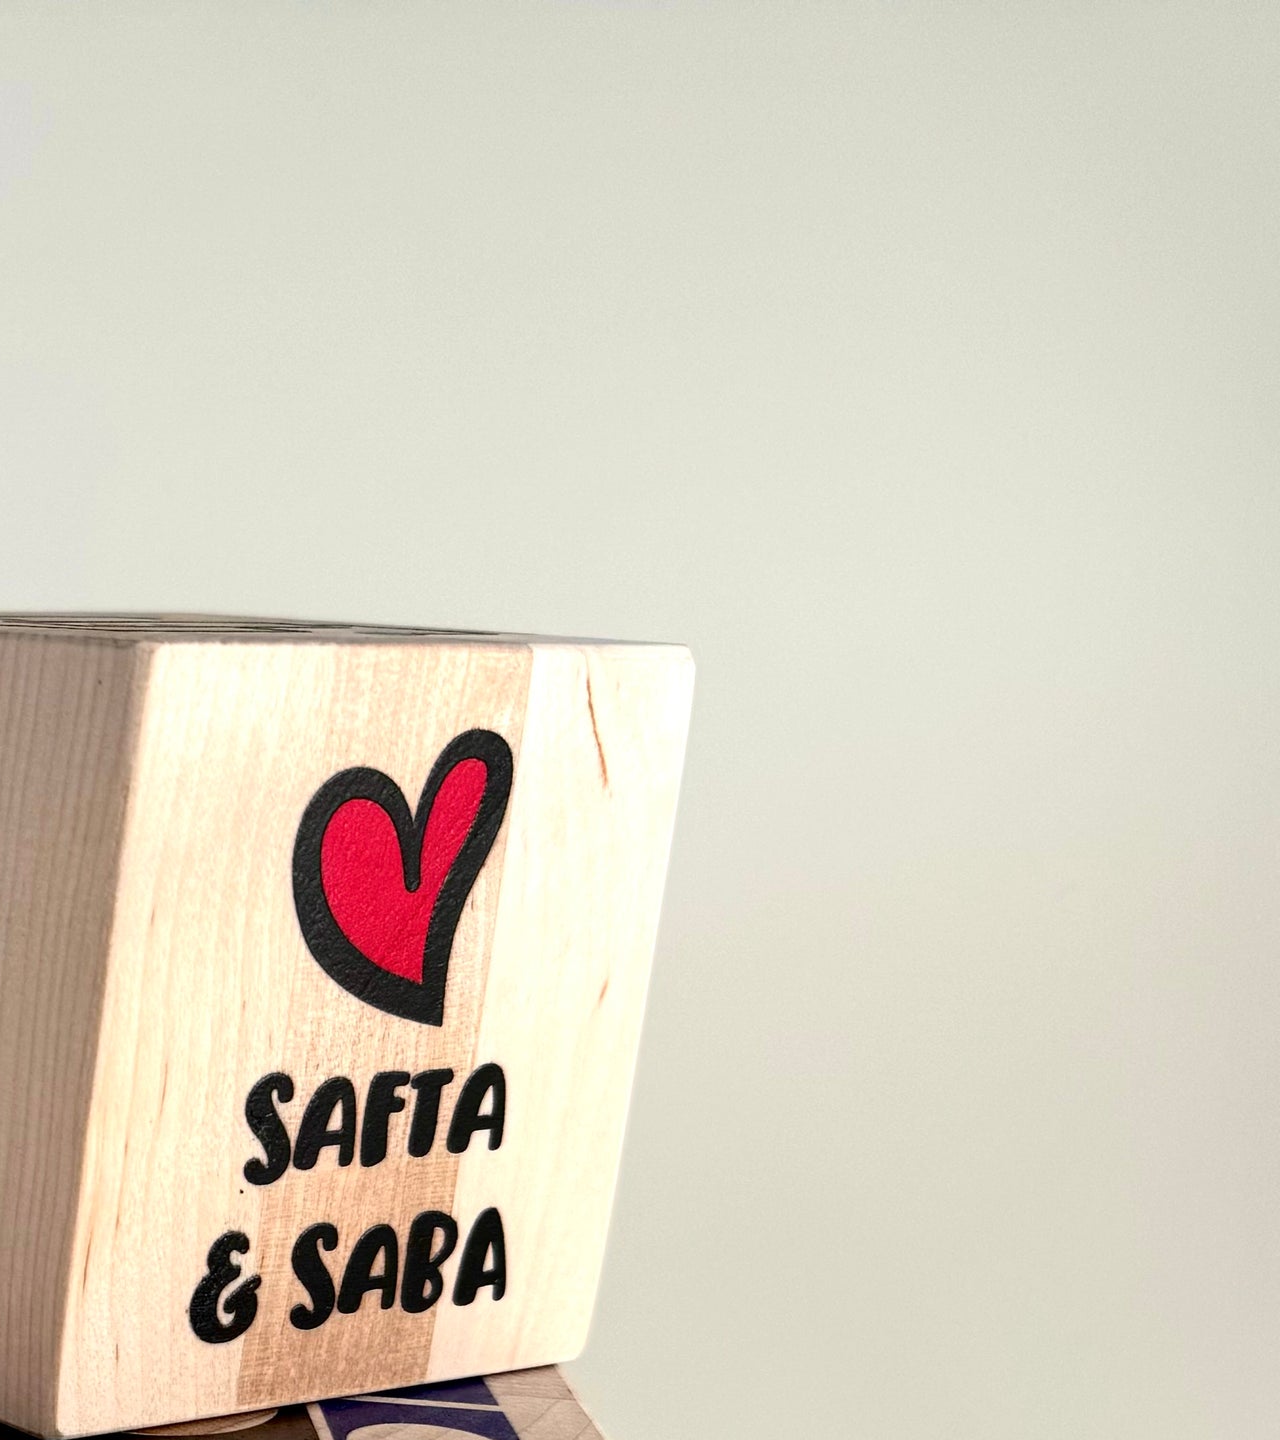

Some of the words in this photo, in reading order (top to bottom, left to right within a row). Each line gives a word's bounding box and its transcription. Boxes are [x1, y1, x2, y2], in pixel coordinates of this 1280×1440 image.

[242, 1062, 505, 1186] SAFTA
[188, 1230, 261, 1344] &
[289, 1207, 507, 1330] SABA
